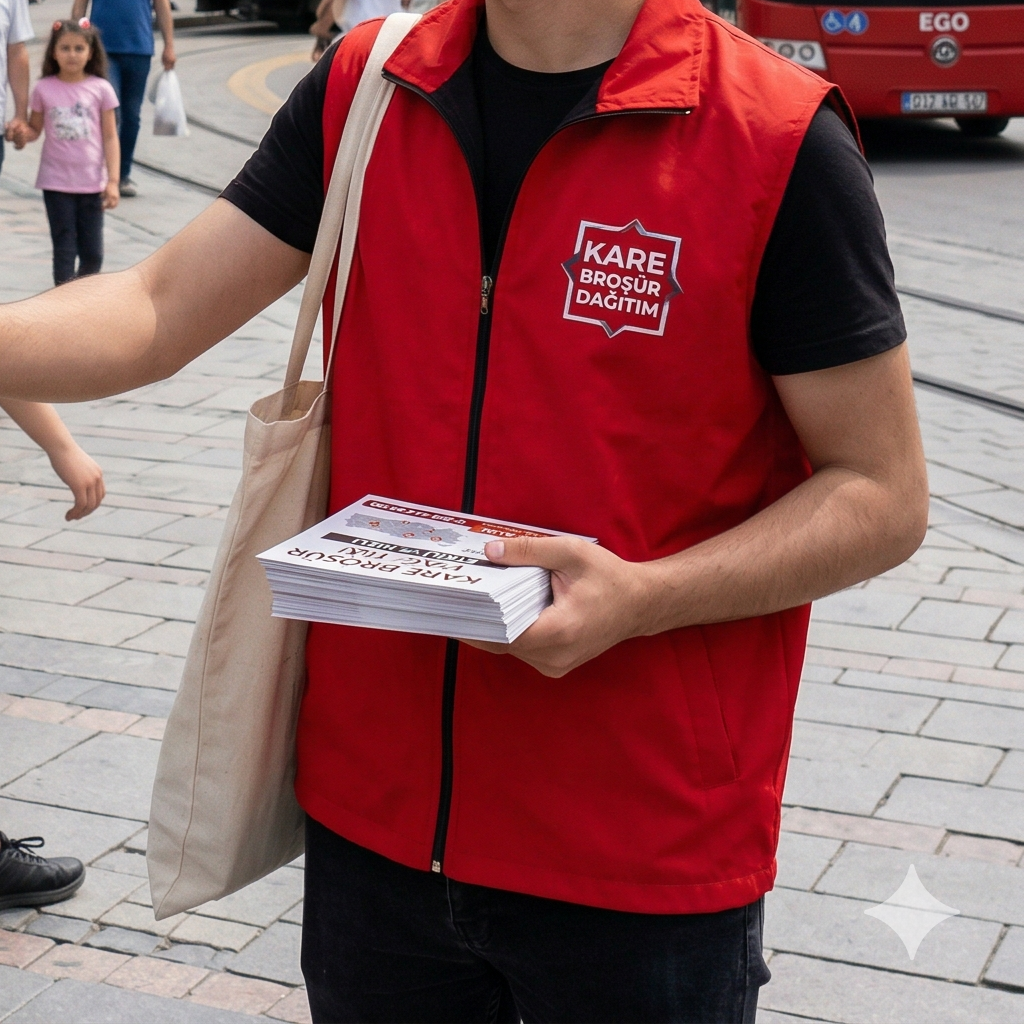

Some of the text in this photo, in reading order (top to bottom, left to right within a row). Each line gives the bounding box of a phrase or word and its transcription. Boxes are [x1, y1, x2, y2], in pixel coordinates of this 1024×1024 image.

[919, 12, 970, 32] EGO
[583, 240, 667, 275] KARE
[579, 268, 661, 297] BROŞÜR
[576, 289, 659, 318] DAĞITIM
